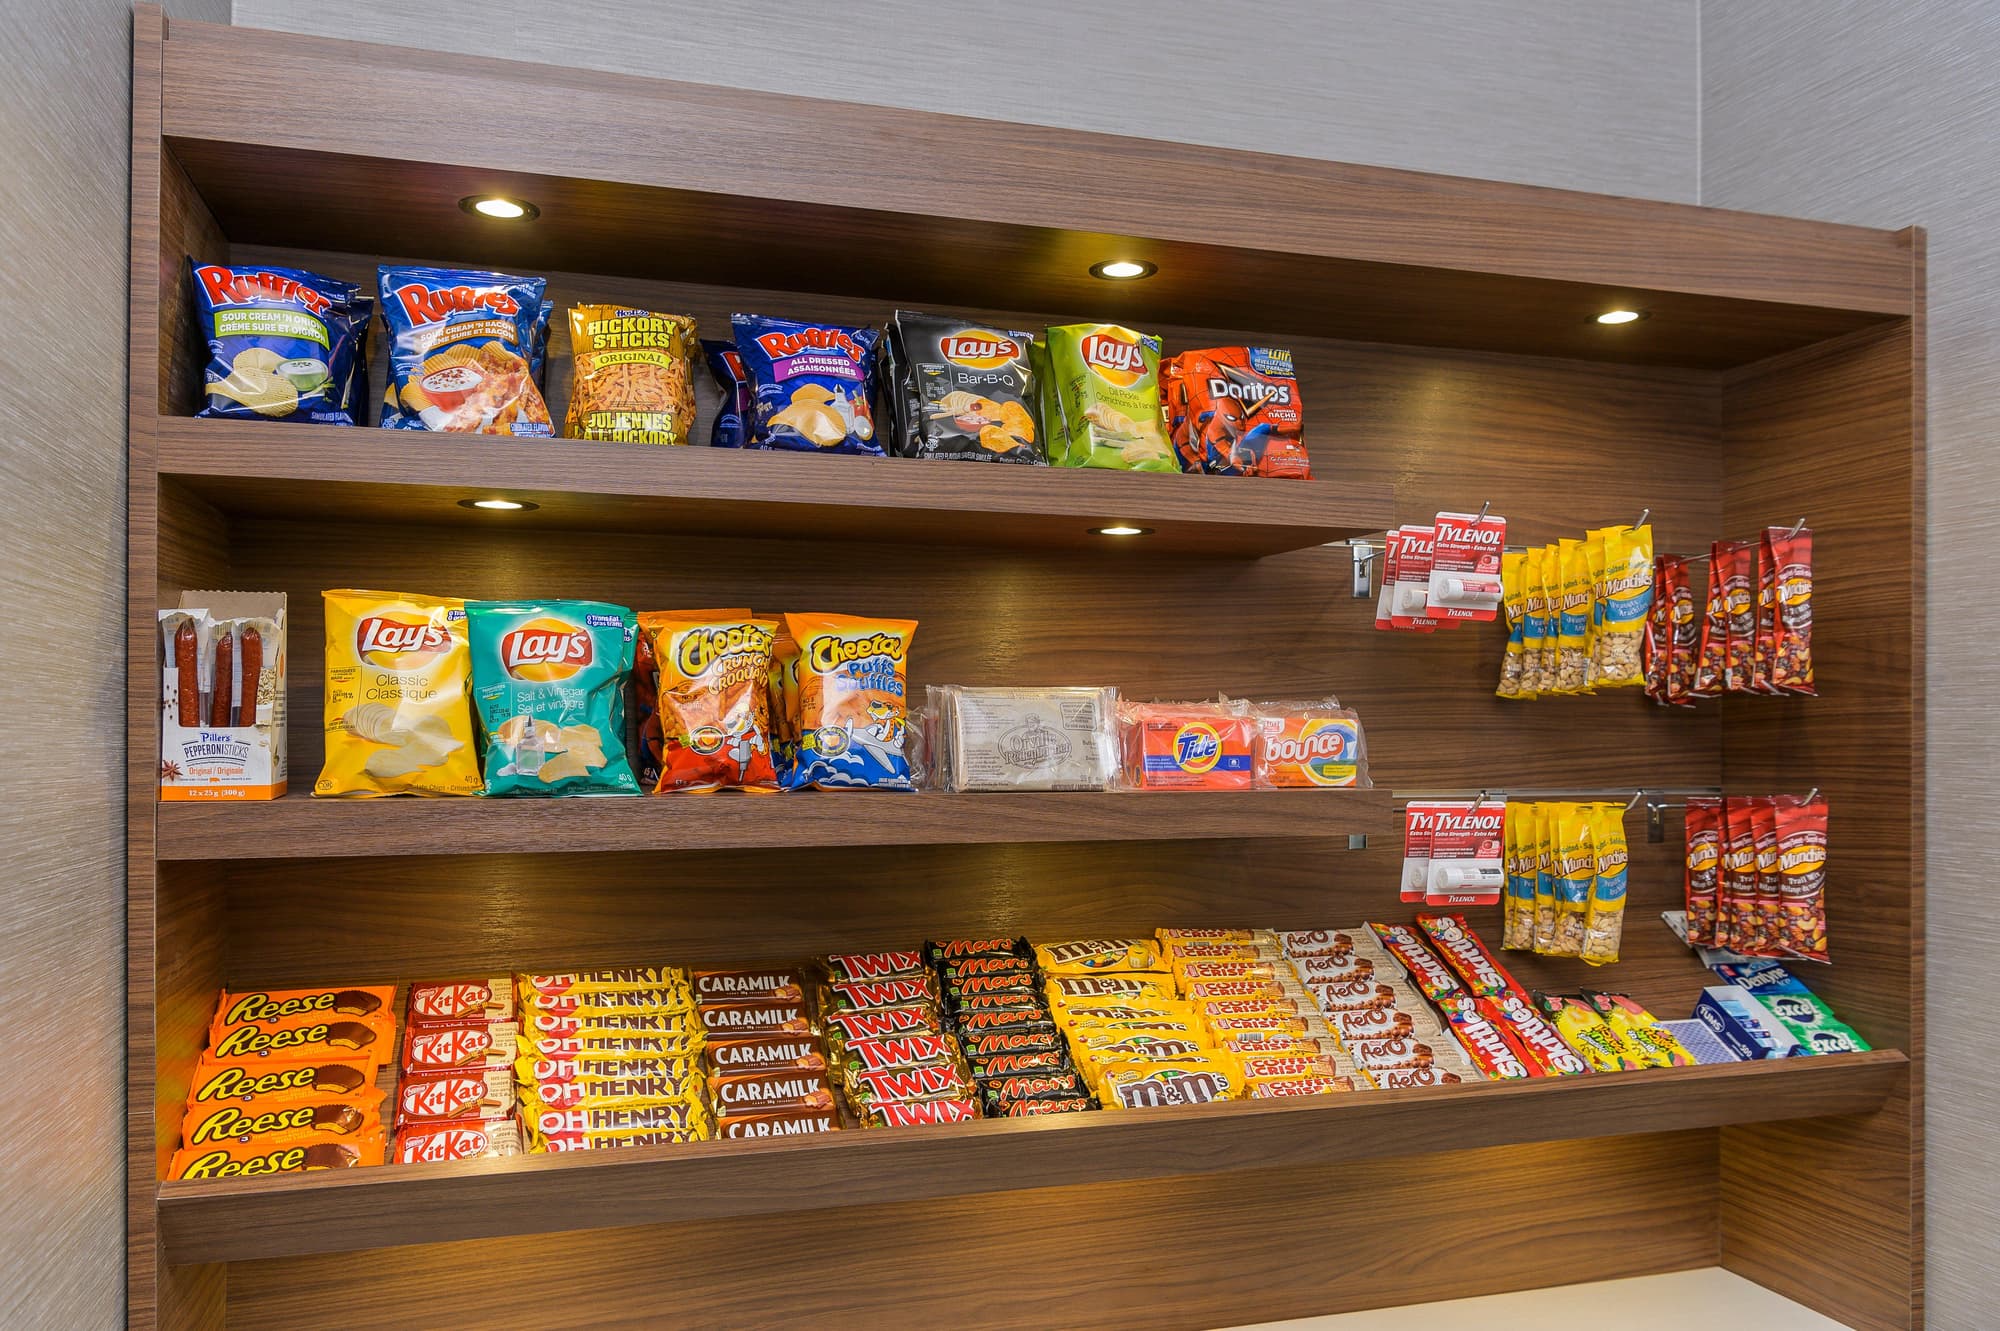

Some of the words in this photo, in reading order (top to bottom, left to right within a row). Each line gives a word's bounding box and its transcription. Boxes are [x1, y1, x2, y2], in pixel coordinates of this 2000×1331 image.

[195, 265, 334, 317] Ruffles
[396, 284, 520, 327] Ruffles
[220, 321, 250, 334] CRÈME
[252, 323, 277, 333] SURE
[279, 323, 290, 333] ET
[291, 325, 327, 343] OIGNON
[222, 312, 248, 322] SOUR
[249, 312, 282, 323] CREAM
[295, 316, 324, 332] ONION
[421, 328, 445, 342] SOUR
[446, 322, 475, 336] CREAM
[485, 320, 515, 332] BACON
[588, 317, 677, 337] HICKORY
[451, 329, 472, 340] SURE
[473, 327, 484, 336] ET
[485, 328, 515, 341] BACON
[593, 332, 671, 349] STICKS
[756, 327, 865, 363] Ruffles
[599, 351, 664, 364] ORIGINAL
[791, 358, 808, 366] ALL
[809, 357, 850, 367] DRESSED
[787, 364, 857, 377] ASSAISONNÉES
[1209, 379, 1290, 403] Doritos
[589, 412, 672, 431] JULIENNES
[1437, 523, 1502, 545] TYLENOL
[1401, 535, 1434, 555] TYLE
[1605, 574, 1653, 597] Munchies
[1411, 616, 1438, 626] TYLENOL
[1447, 608, 1474, 618] TYLENOL
[509, 631, 587, 667] Lay's
[679, 624, 774, 679] Cheetos
[811, 633, 903, 673] Cheetos
[376, 673, 428, 687] Classic
[365, 687, 438, 701] Classique
[516, 689, 535, 703] Salt
[538, 690, 546, 700] &
[547, 685, 585, 699] Vinegar
[517, 702, 534, 715] Sel
[536, 702, 546, 714] et
[548, 697, 586, 712] vinaigre
[200, 732, 231, 742] Piller's
[1177, 734, 1219, 764] Tide
[1265, 734, 1343, 764] bounce
[188, 766, 213, 776] Original
[1434, 812, 1503, 831] TYLENOL
[1779, 849, 1827, 873] Munchies
[1448, 895, 1476, 904] TYLENOL
[1180, 930, 1227, 938] CRISP
[1287, 930, 1329, 949] Aero
[944, 937, 1013, 958] Mars
[1184, 949, 1232, 957] CRISP
[1436, 916, 1508, 988] Skittles
[828, 951, 921, 982] TWIX
[1197, 962, 1257, 970] COFFEE
[1305, 954, 1349, 973] Aero
[1388, 925, 1461, 992] Skittles
[1199, 968, 1247, 977] CRISP
[1736, 967, 1790, 990] Dentyne
[698, 974, 791, 993] CARAMILK
[833, 978, 935, 1009] TWIX
[961, 973, 1032, 996] Mars
[1205, 981, 1265, 990] COFFEE
[1207, 988, 1256, 996] CRISP
[1325, 981, 1370, 1002] Aero
[224, 993, 336, 1026] Reese
[534, 994, 580, 1009] OH
[1220, 1005, 1269, 1014] CRISP
[1774, 998, 1820, 1018] excel
[534, 1016, 582, 1032] OH
[703, 1008, 799, 1027] CARAMILK
[827, 1007, 930, 1040] TWIX
[967, 1008, 1042, 1031] Mars
[1229, 1020, 1279, 1029] CRISP
[1342, 1008, 1388, 1031] Aero
[1699, 1005, 1723, 1032] TUMS
[215, 1024, 328, 1058] Reese
[1456, 997, 1529, 1078] Skittles
[1503, 997, 1585, 1073] Skittles
[1811, 1033, 1858, 1053] excel
[715, 1043, 812, 1065] CARAMILK
[844, 1034, 953, 1070] TWIX
[1240, 1043, 1290, 1052] CRISP
[1360, 1038, 1407, 1062] Aero
[534, 1060, 580, 1080] OH
[986, 1051, 1060, 1077] Mars
[1252, 1056, 1317, 1067] COFFEE
[1254, 1065, 1307, 1076] CRISP
[195, 1067, 316, 1103] Reese
[858, 1062, 966, 1102] TWIX
[999, 1074, 1075, 1101] Mars
[1269, 1077, 1334, 1089] COFFEE
[1387, 1067, 1436, 1089] Aero
[538, 1083, 586, 1103] OH
[720, 1077, 820, 1104] CARAMILK
[1117, 1072, 1229, 1108] m&m's
[1272, 1086, 1324, 1097] CRISP
[539, 1110, 591, 1134] OH
[869, 1099, 975, 1127] TWIX
[190, 1106, 315, 1145] Reese
[728, 1117, 831, 1139] CARAMILK
[181, 1145, 305, 1180] Reese
